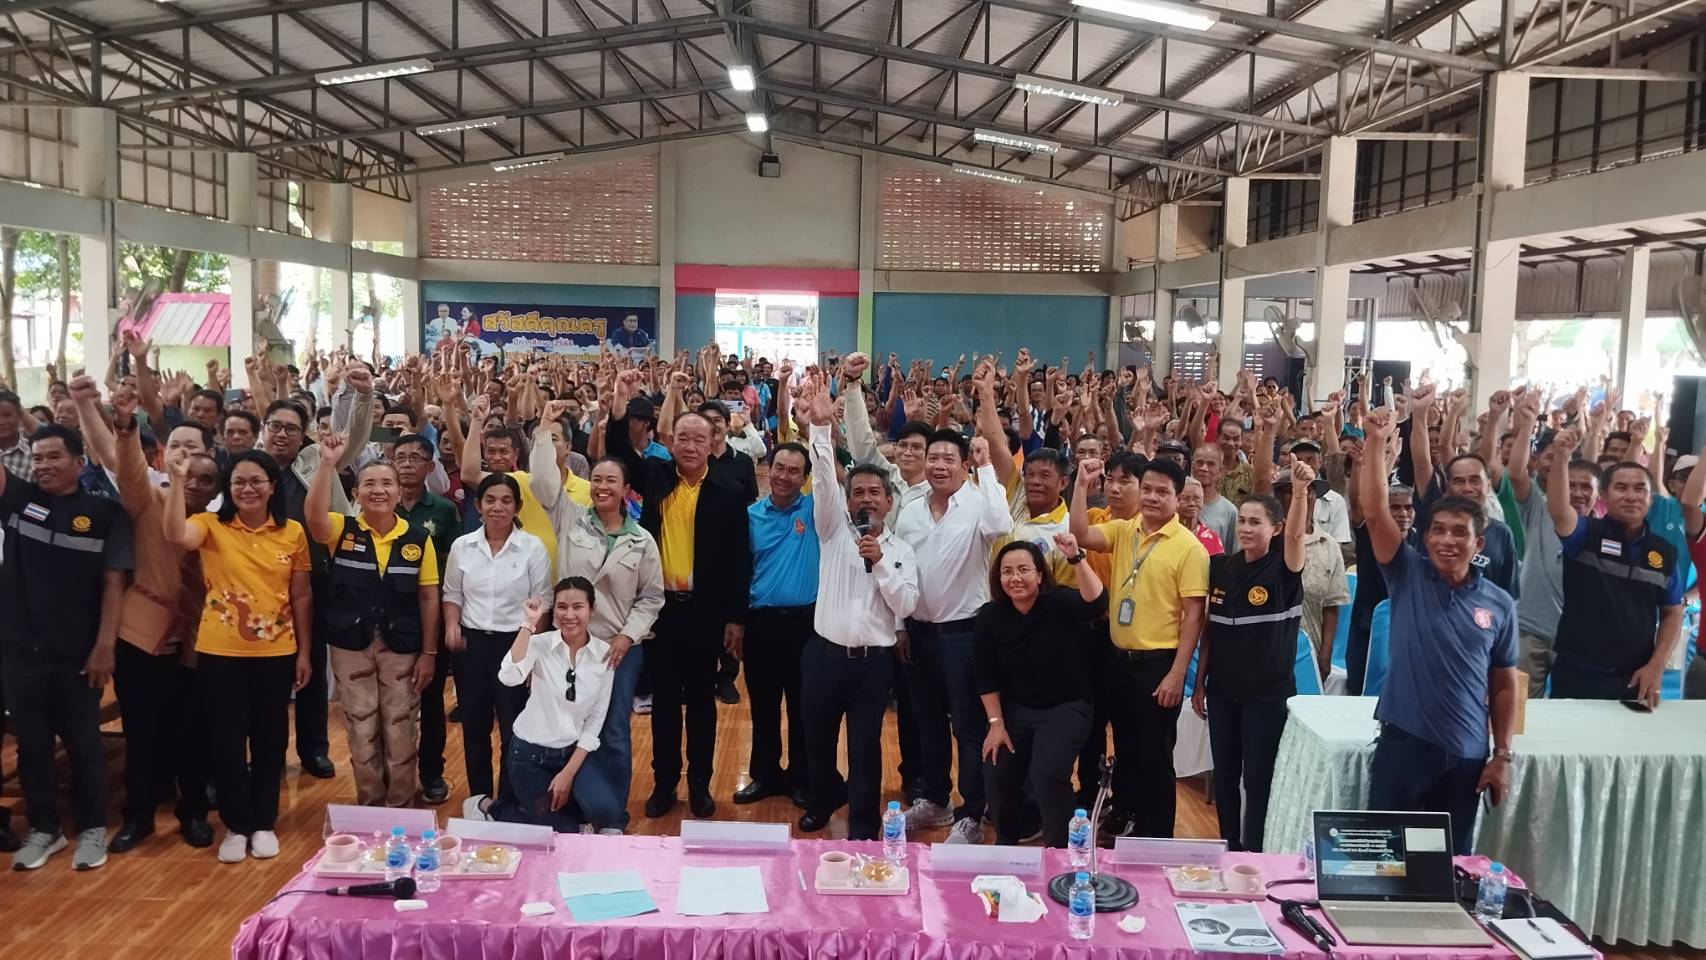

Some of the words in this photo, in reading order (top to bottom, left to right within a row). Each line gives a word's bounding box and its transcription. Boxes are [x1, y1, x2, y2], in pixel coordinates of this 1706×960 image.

[482, 310, 607, 338] สวัสดีคุณครู
[1470, 553, 1490, 567] EEP
